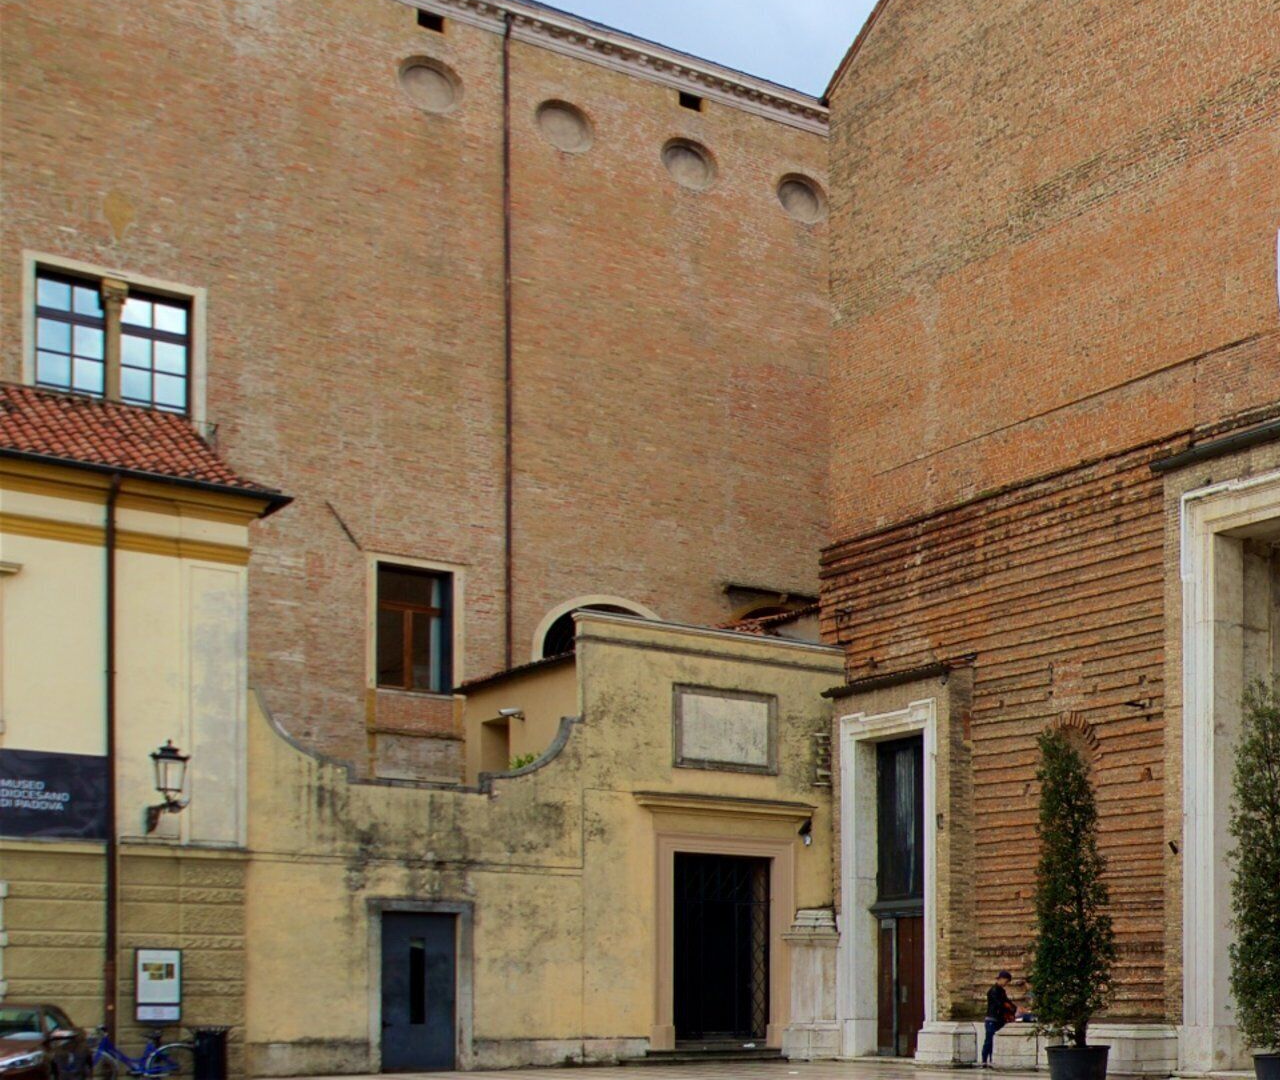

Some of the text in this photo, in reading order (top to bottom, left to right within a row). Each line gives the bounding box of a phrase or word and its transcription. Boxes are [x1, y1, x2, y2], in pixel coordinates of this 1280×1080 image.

[0, 779, 45, 790] MUSEO
[0, 789, 70, 802] DIOCESANO
[0, 799, 64, 811] DI PADOVA
